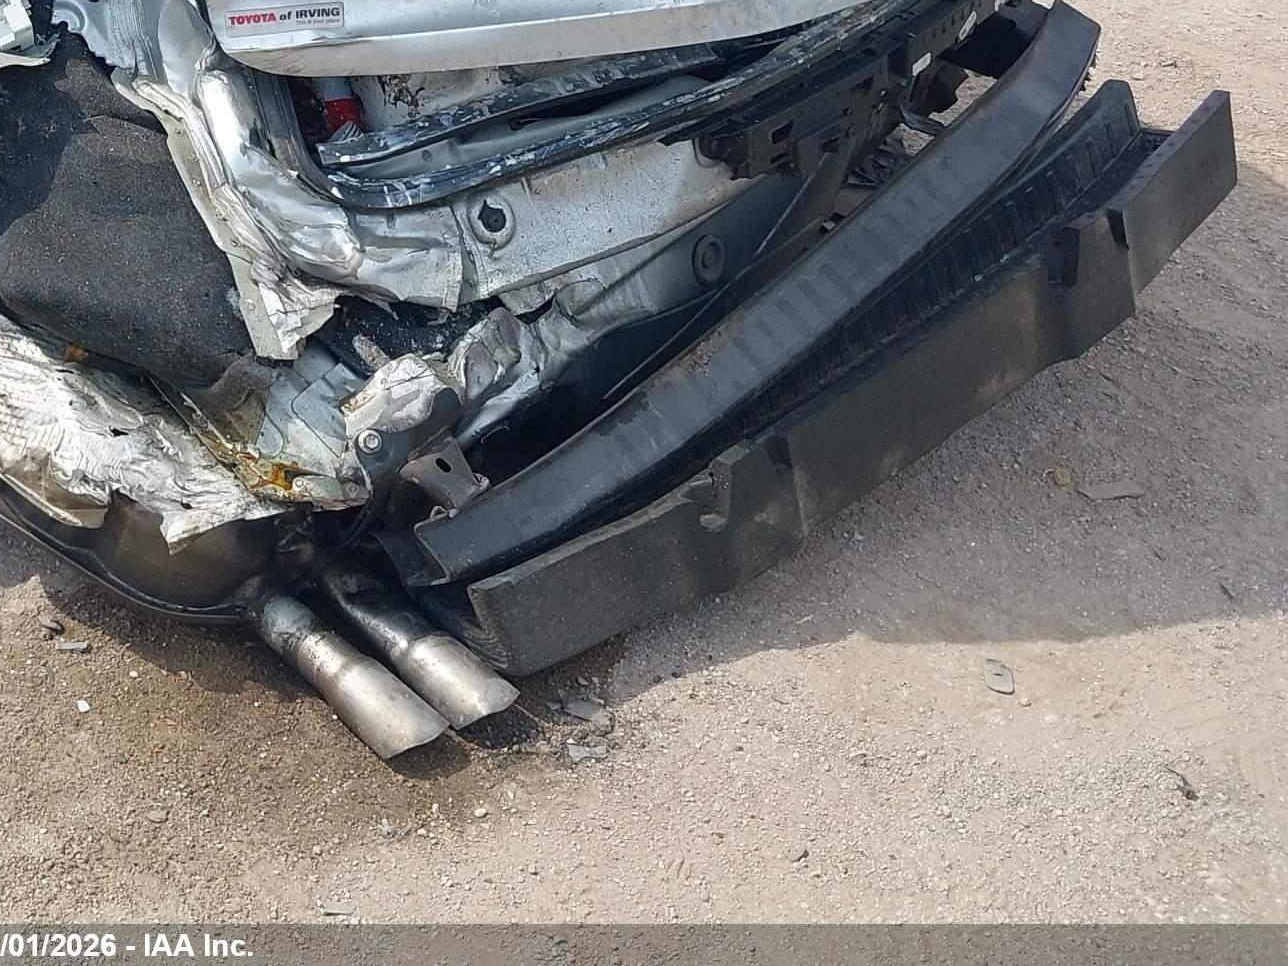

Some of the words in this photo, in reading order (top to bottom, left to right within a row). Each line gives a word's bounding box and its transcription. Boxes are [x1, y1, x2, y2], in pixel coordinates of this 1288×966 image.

[228, 13, 277, 26] TOYOTA
[279, 11, 292, 21] of
[295, 7, 340, 19] IRVING
